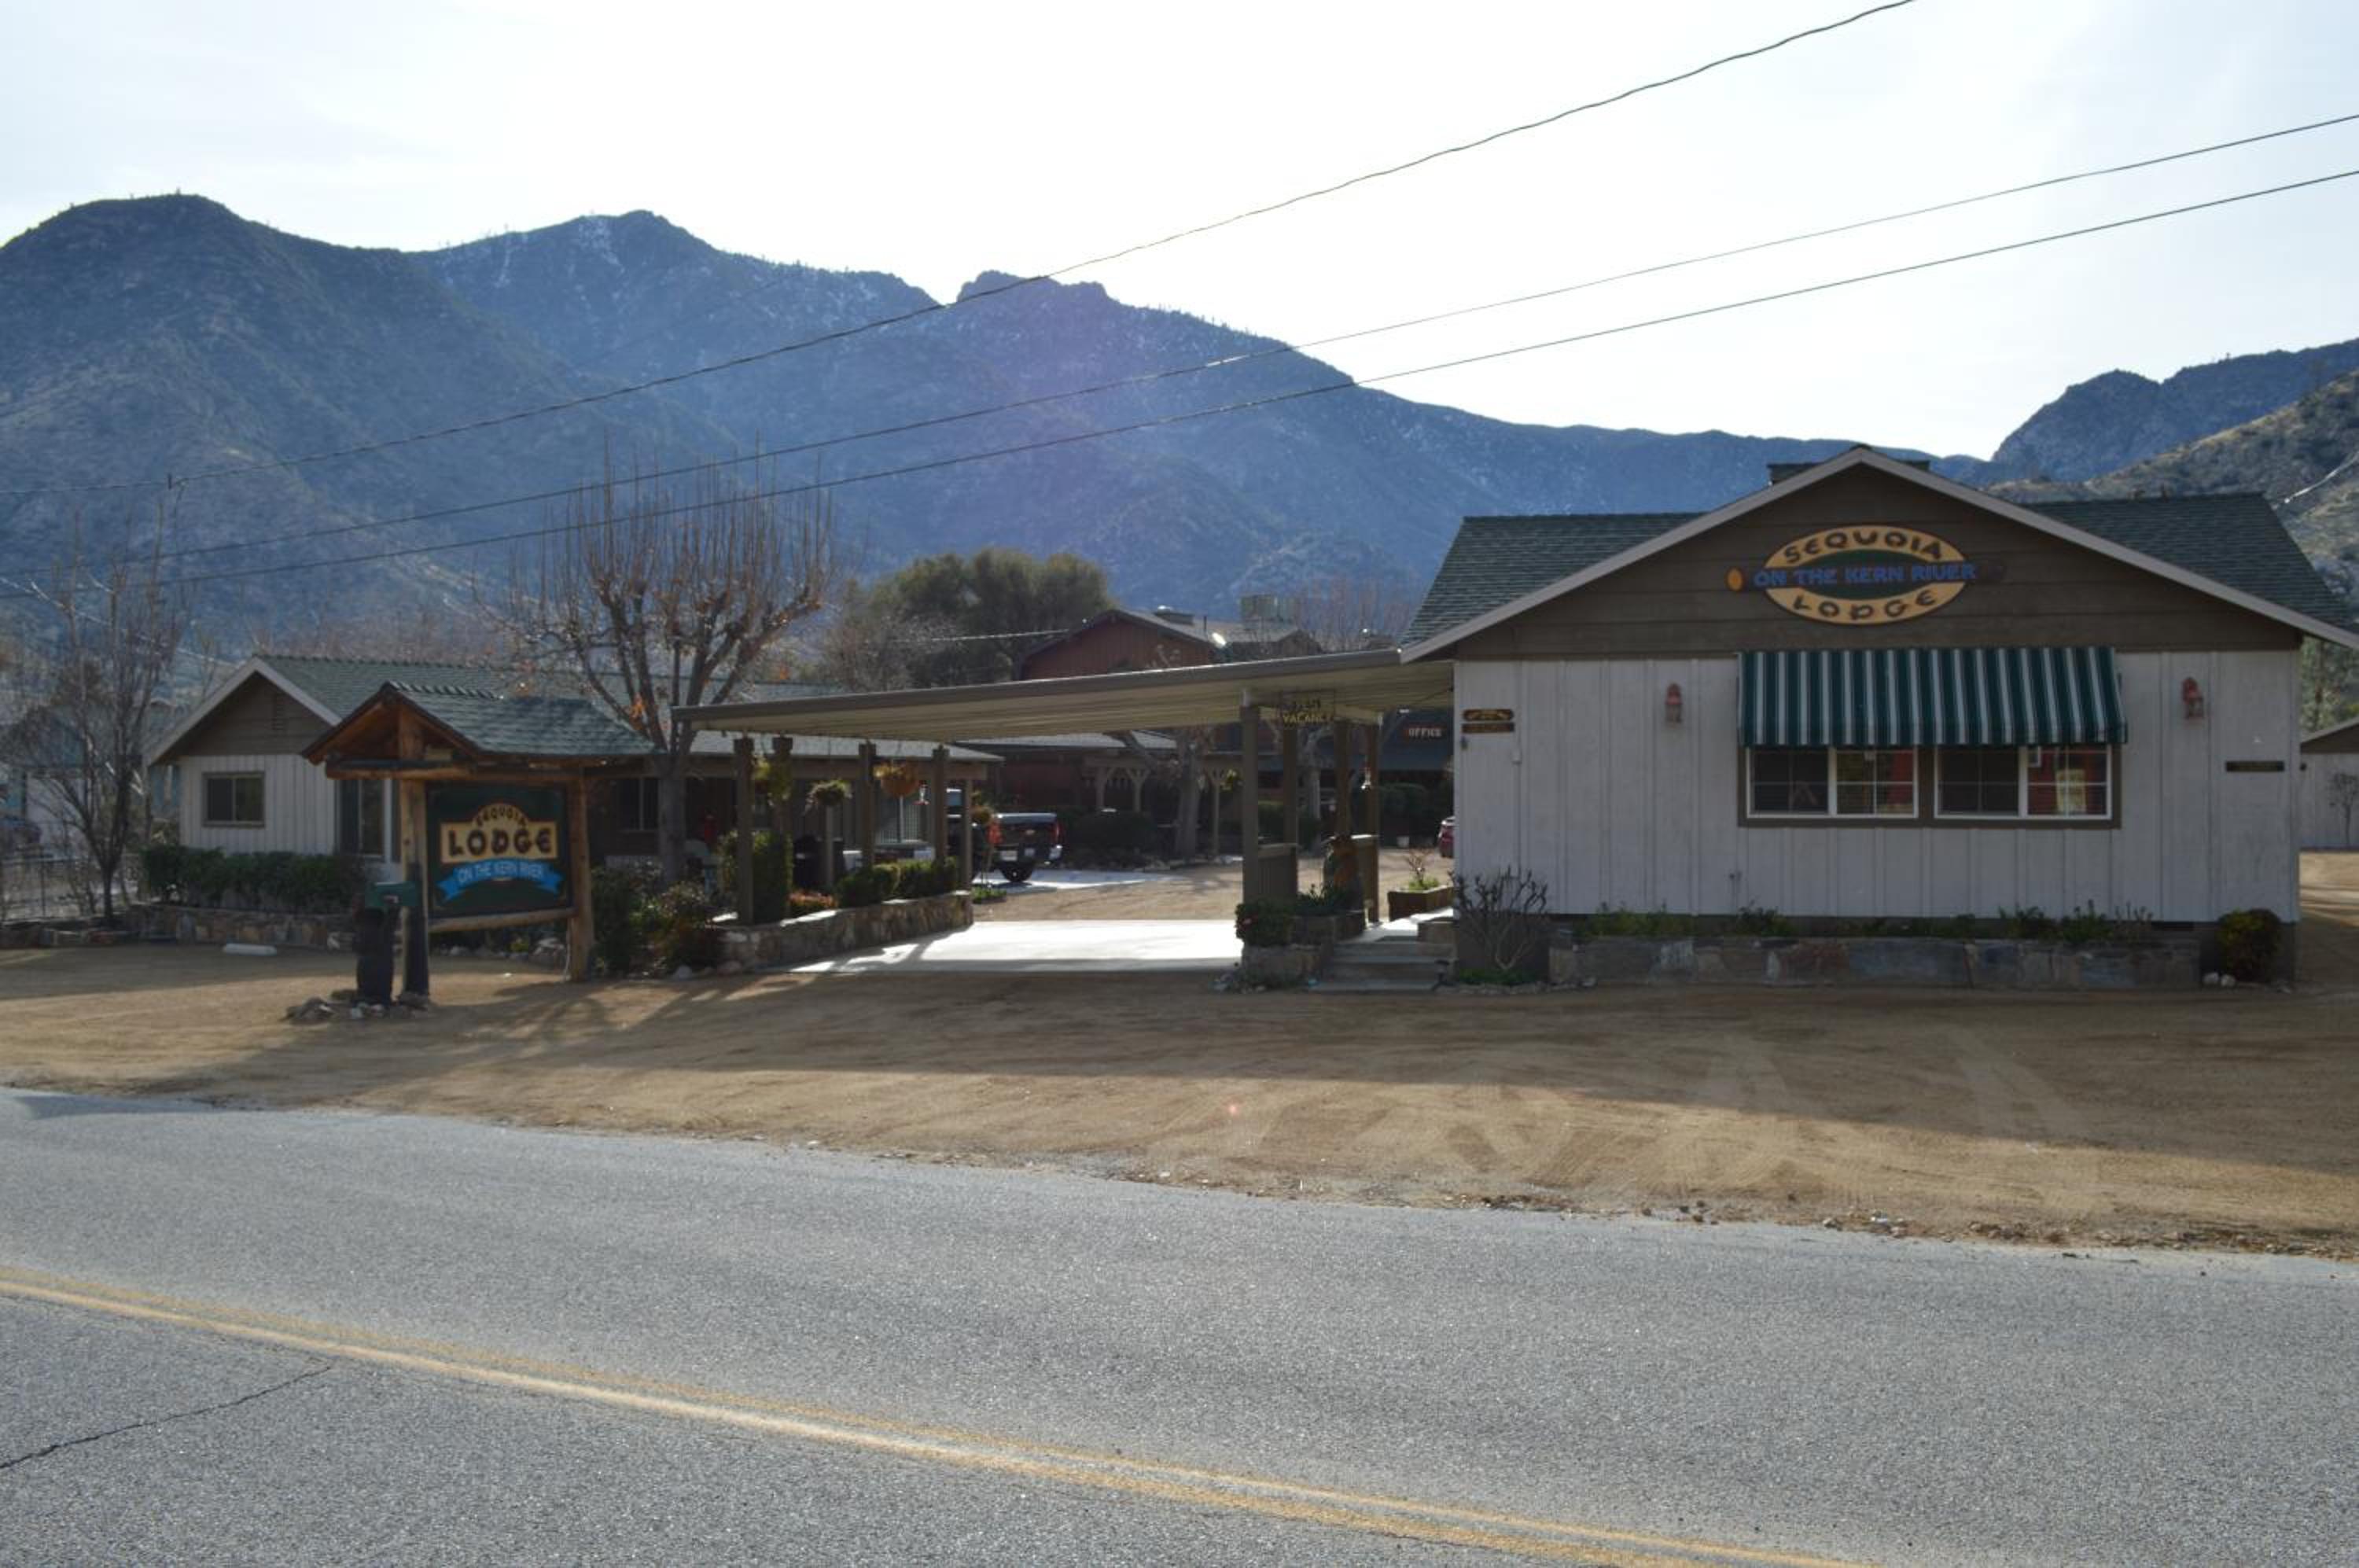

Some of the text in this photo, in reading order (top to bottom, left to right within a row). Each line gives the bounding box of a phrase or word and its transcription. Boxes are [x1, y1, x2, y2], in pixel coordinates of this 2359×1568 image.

[1783, 530, 1942, 564] SEQUOIA
[1753, 563, 1977, 587] ON THE KERN RIVER
[1792, 589, 1938, 621] LODGE
[1408, 727, 1443, 739] OFFICE
[476, 805, 527, 826] SEQUOIA
[447, 827, 552, 856] LODGE
[458, 867, 473, 883] ON
